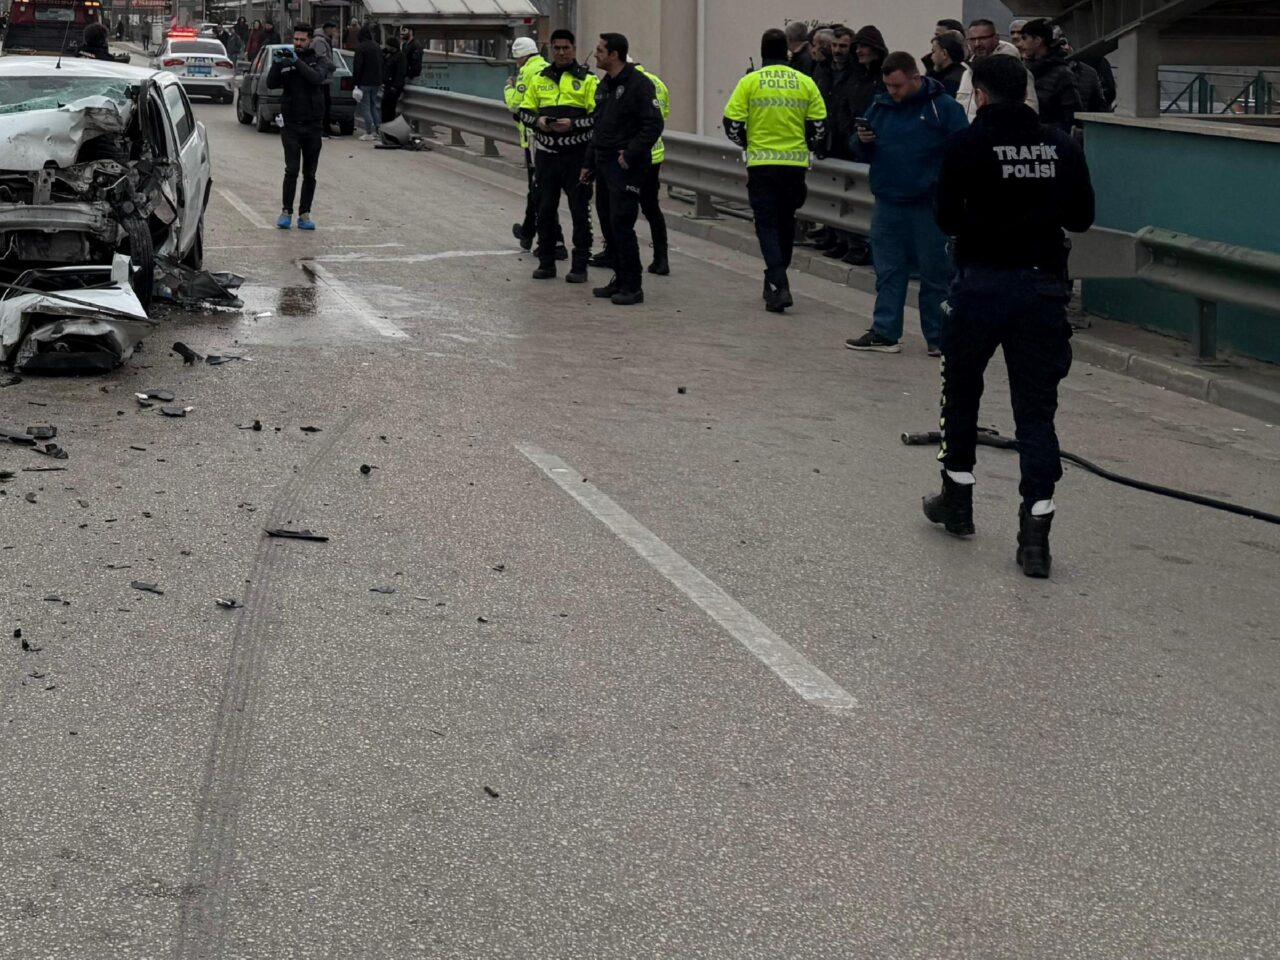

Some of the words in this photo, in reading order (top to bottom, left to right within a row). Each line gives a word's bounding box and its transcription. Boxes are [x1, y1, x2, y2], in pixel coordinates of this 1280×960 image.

[759, 79, 800, 90] POLİSİ
[992, 142, 1059, 160] TRAFİK
[1002, 161, 1056, 178] POLİSİ
